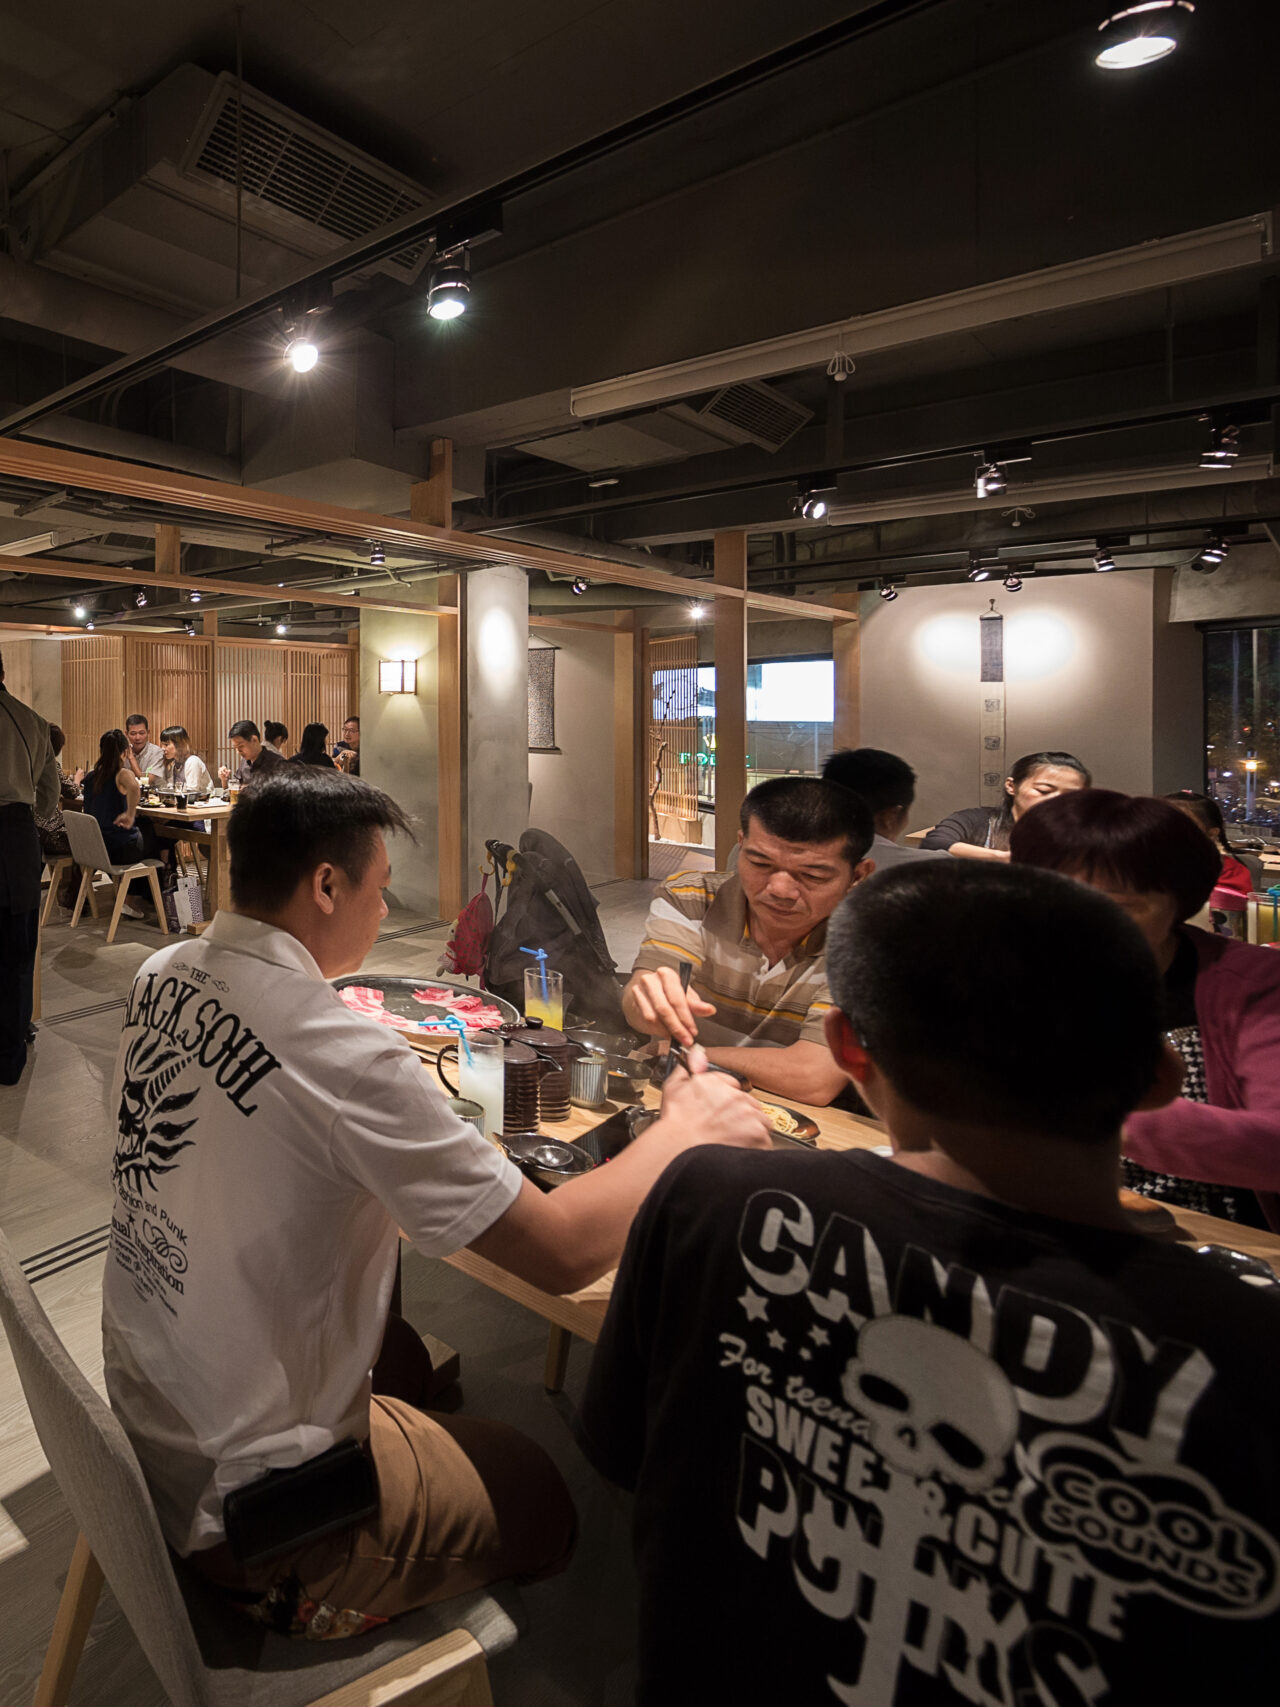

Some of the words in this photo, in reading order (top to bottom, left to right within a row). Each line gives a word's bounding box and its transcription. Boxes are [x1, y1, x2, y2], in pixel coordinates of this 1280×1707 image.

[189, 967, 211, 985] THE
[122, 973, 200, 1046] LACK
[177, 998, 282, 1117] SOUL
[134, 1229, 184, 1296] Inspiration
[160, 1208, 188, 1246] Punk
[718, 1331, 773, 1385] For
[737, 1188, 1217, 1466] CANDY
[1045, 1505, 1254, 1599] SOUNDS
[1048, 1467, 1261, 1578] COOL
[953, 1501, 1132, 1643] CUTE
